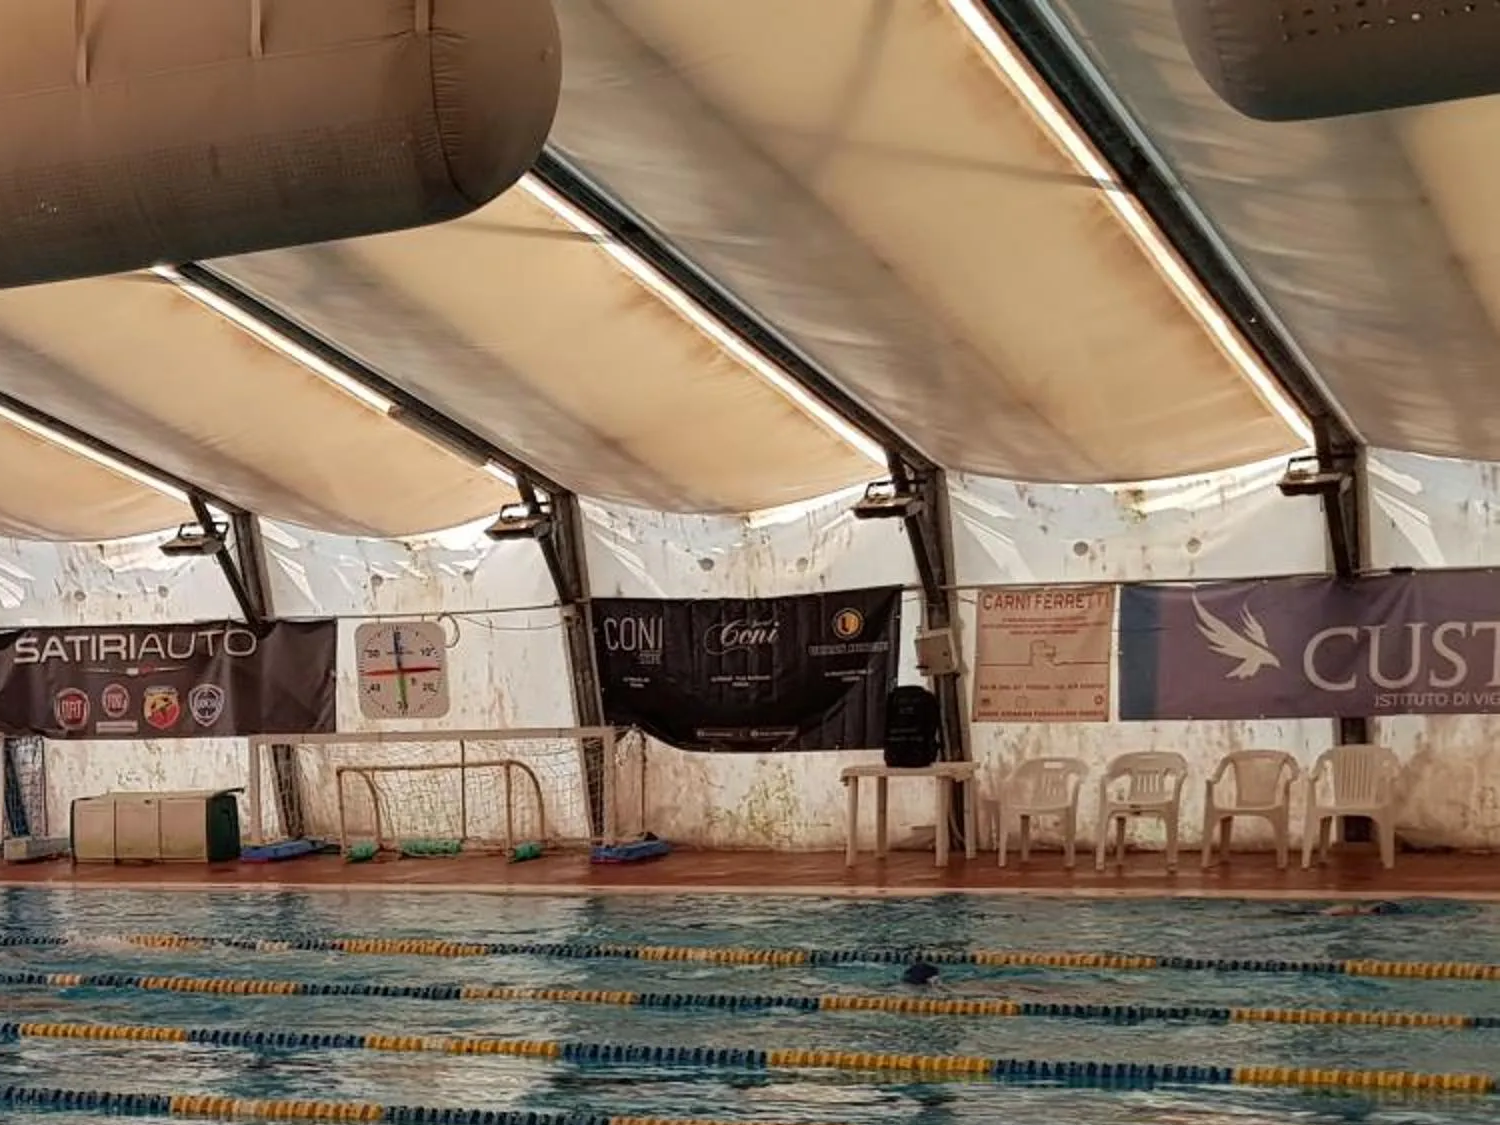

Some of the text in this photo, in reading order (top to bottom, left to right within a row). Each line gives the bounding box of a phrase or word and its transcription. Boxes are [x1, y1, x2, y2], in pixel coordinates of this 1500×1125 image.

[13, 629, 257, 664] SATIRIAUTO
[604, 617, 663, 650] CONI
[1374, 692, 1449, 707] ISTITUTO
[1453, 692, 1471, 705] DI
